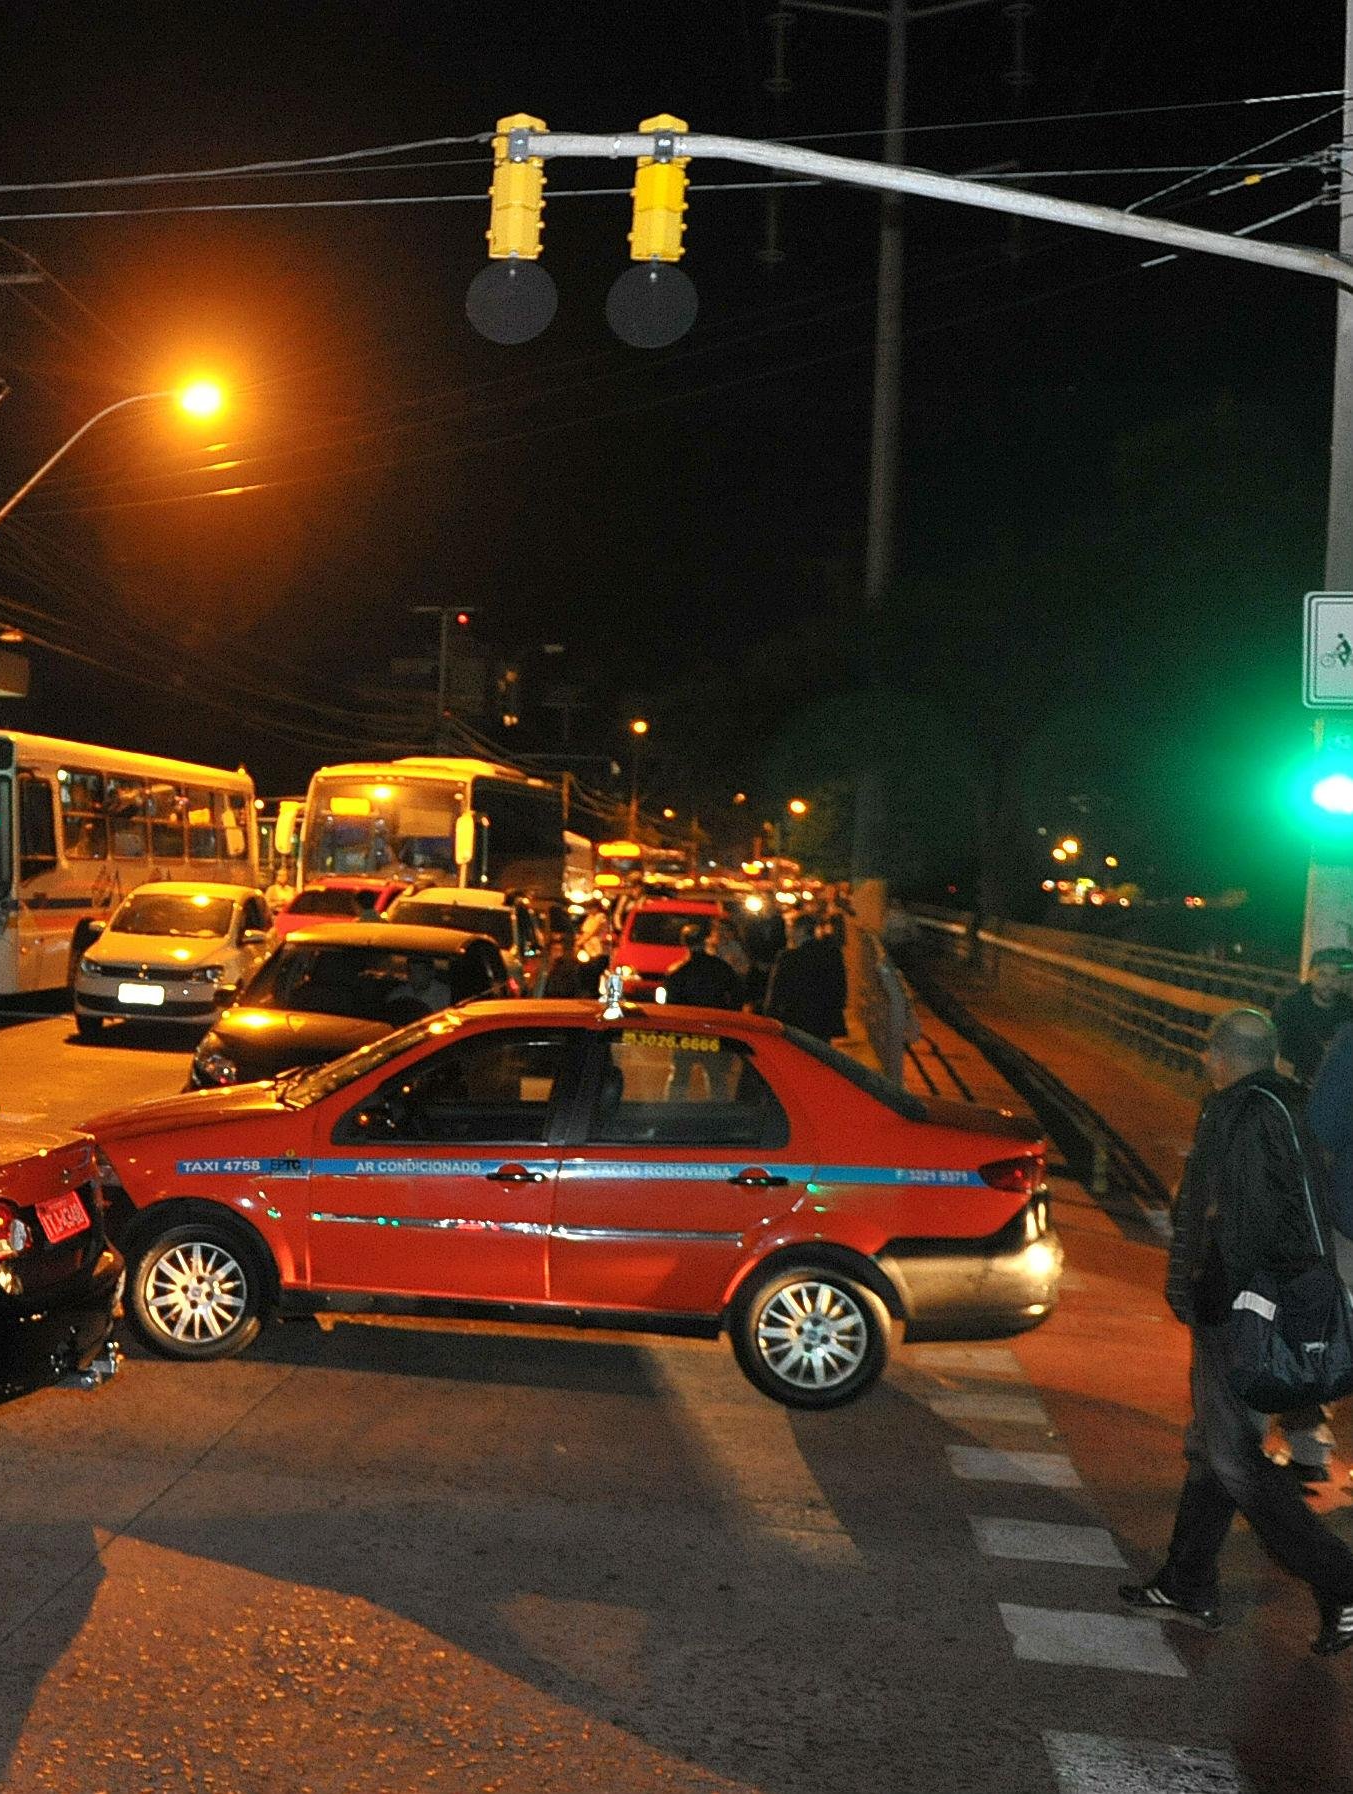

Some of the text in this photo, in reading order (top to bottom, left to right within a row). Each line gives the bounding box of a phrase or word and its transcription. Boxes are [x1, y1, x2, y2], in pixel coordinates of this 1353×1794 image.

[183, 1160, 261, 1172] TAXI 4758
[355, 1161, 481, 1173] AR CONDICIONADO
